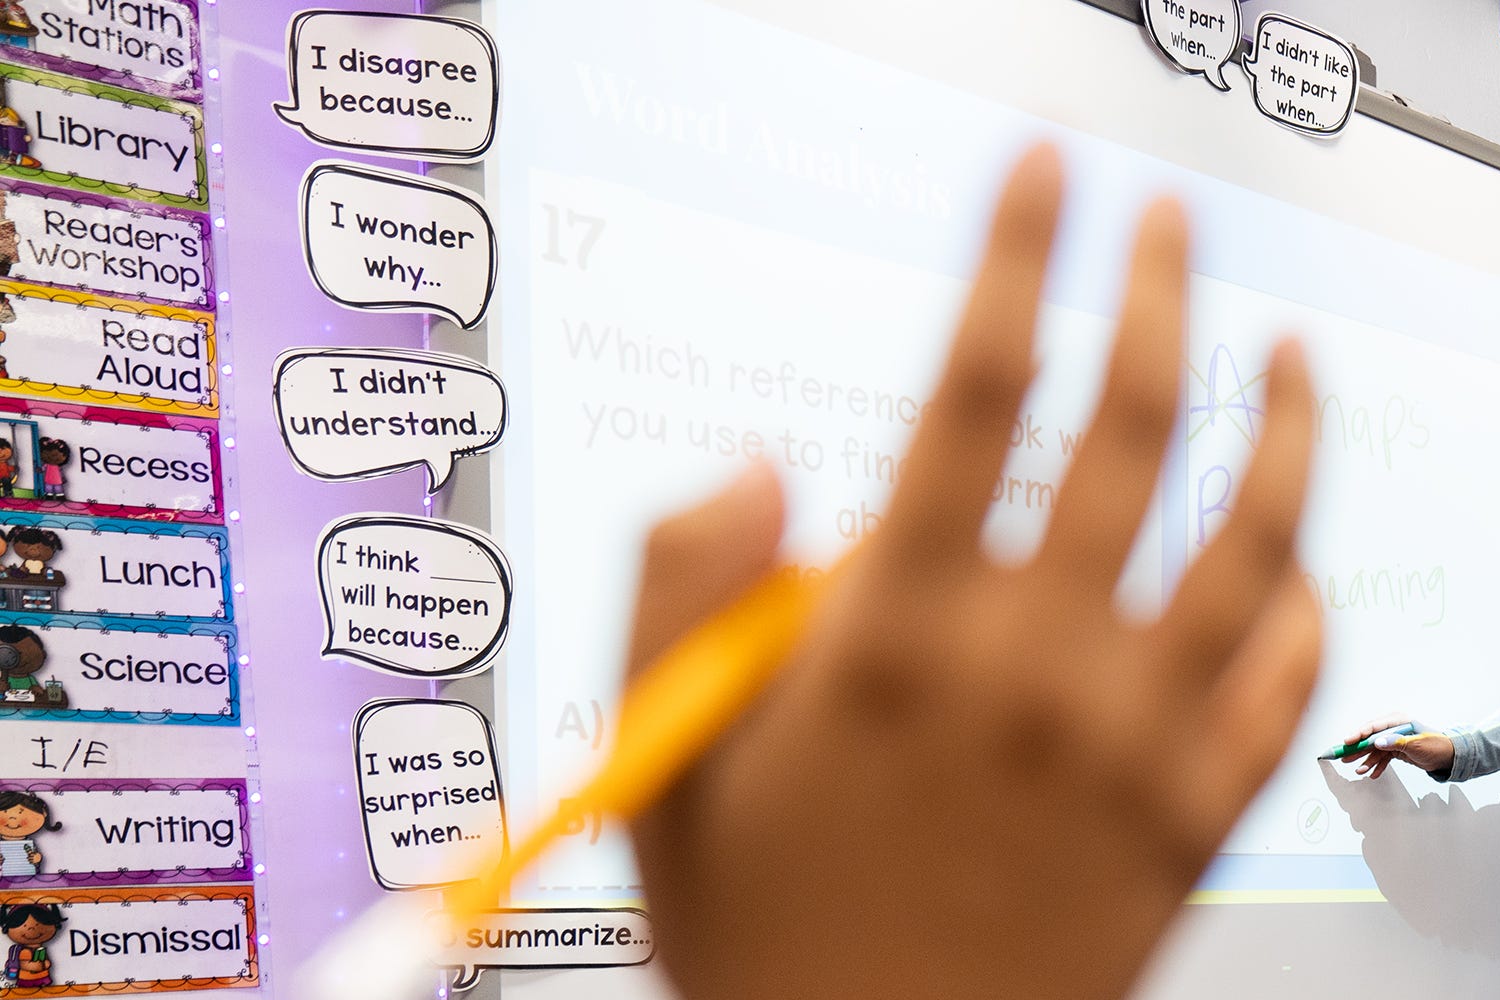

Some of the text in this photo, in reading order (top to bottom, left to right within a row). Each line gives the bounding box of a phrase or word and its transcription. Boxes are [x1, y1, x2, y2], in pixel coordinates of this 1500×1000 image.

[88, 0, 183, 38] Math
[1190, 8, 1225, 33] part
[40, 12, 184, 68] Stations
[1170, 32, 1216, 61] when...
[1262, 31, 1349, 78] I didn't like
[311, 45, 478, 94] I disagree
[1270, 64, 1337, 102] the part
[320, 86, 474, 124] because...
[1276, 99, 1325, 128] when...
[36, 110, 189, 172] Library
[571, 58, 952, 221] Word Analysis
[44, 209, 198, 258] Reader's
[330, 202, 475, 251] I wonder
[540, 203, 607, 271] 17
[27, 239, 200, 292] Workshop
[364, 255, 442, 291] why...
[102, 319, 200, 360] Read
[96, 354, 201, 394] Aloud
[330, 368, 447, 396] I didn't
[561, 317, 924, 428] Which referenc
[290, 409, 498, 439] understand...
[581, 397, 901, 487] you use to fin
[79, 446, 210, 483] Recess
[100, 555, 216, 590] Lunch
[336, 542, 420, 574] I think
[341, 583, 489, 619] will happen
[1306, 566, 1446, 628] eaning
[348, 621, 480, 653] because...
[79, 651, 228, 686] Science
[554, 699, 605, 751] A)
[31, 736, 109, 771] I/E
[365, 747, 485, 775] I was so
[364, 781, 497, 815] surprised
[96, 815, 235, 848] Writing
[391, 823, 482, 848] when...
[69, 923, 241, 958] Dismissal
[466, 924, 651, 949] summarize...
